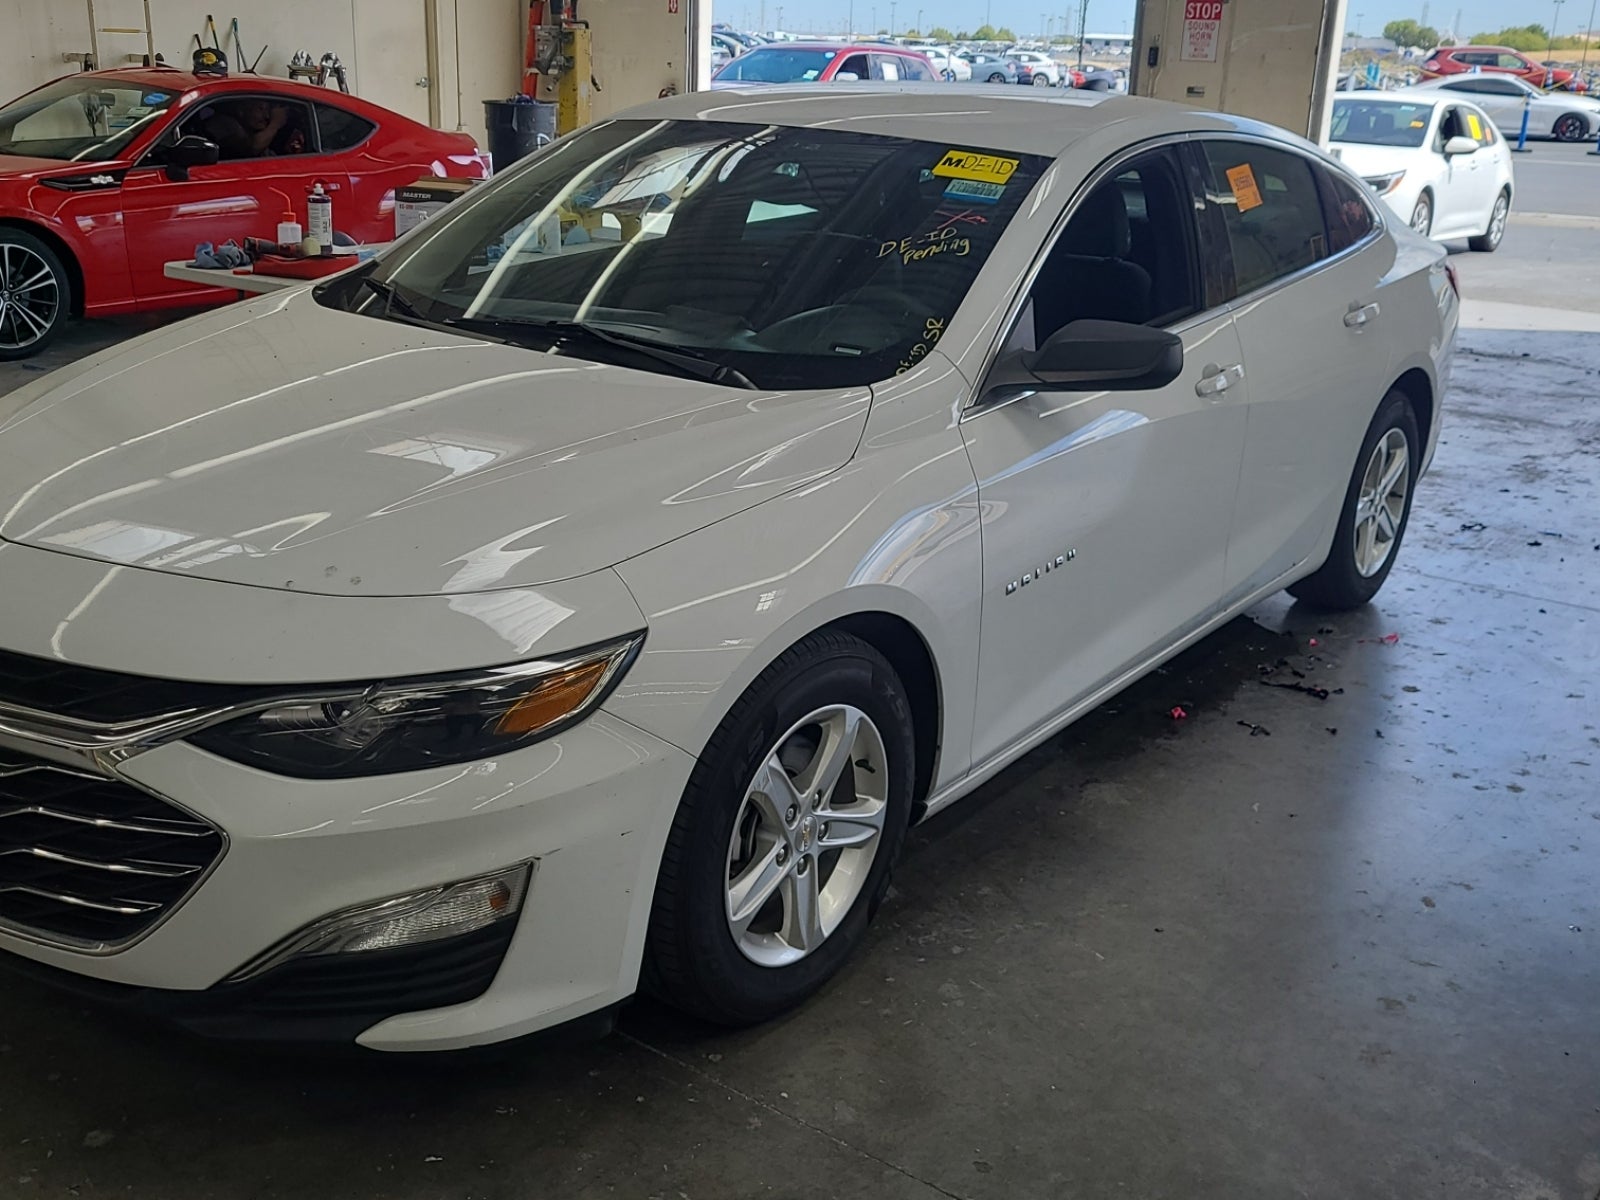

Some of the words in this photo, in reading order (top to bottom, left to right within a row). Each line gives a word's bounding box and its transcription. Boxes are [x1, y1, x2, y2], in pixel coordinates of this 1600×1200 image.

[1186, 2, 1221, 18] STOP
[1188, 21, 1216, 31] SOUND
[1189, 32, 1212, 40] HORN
[402, 191, 432, 199] MASTER
